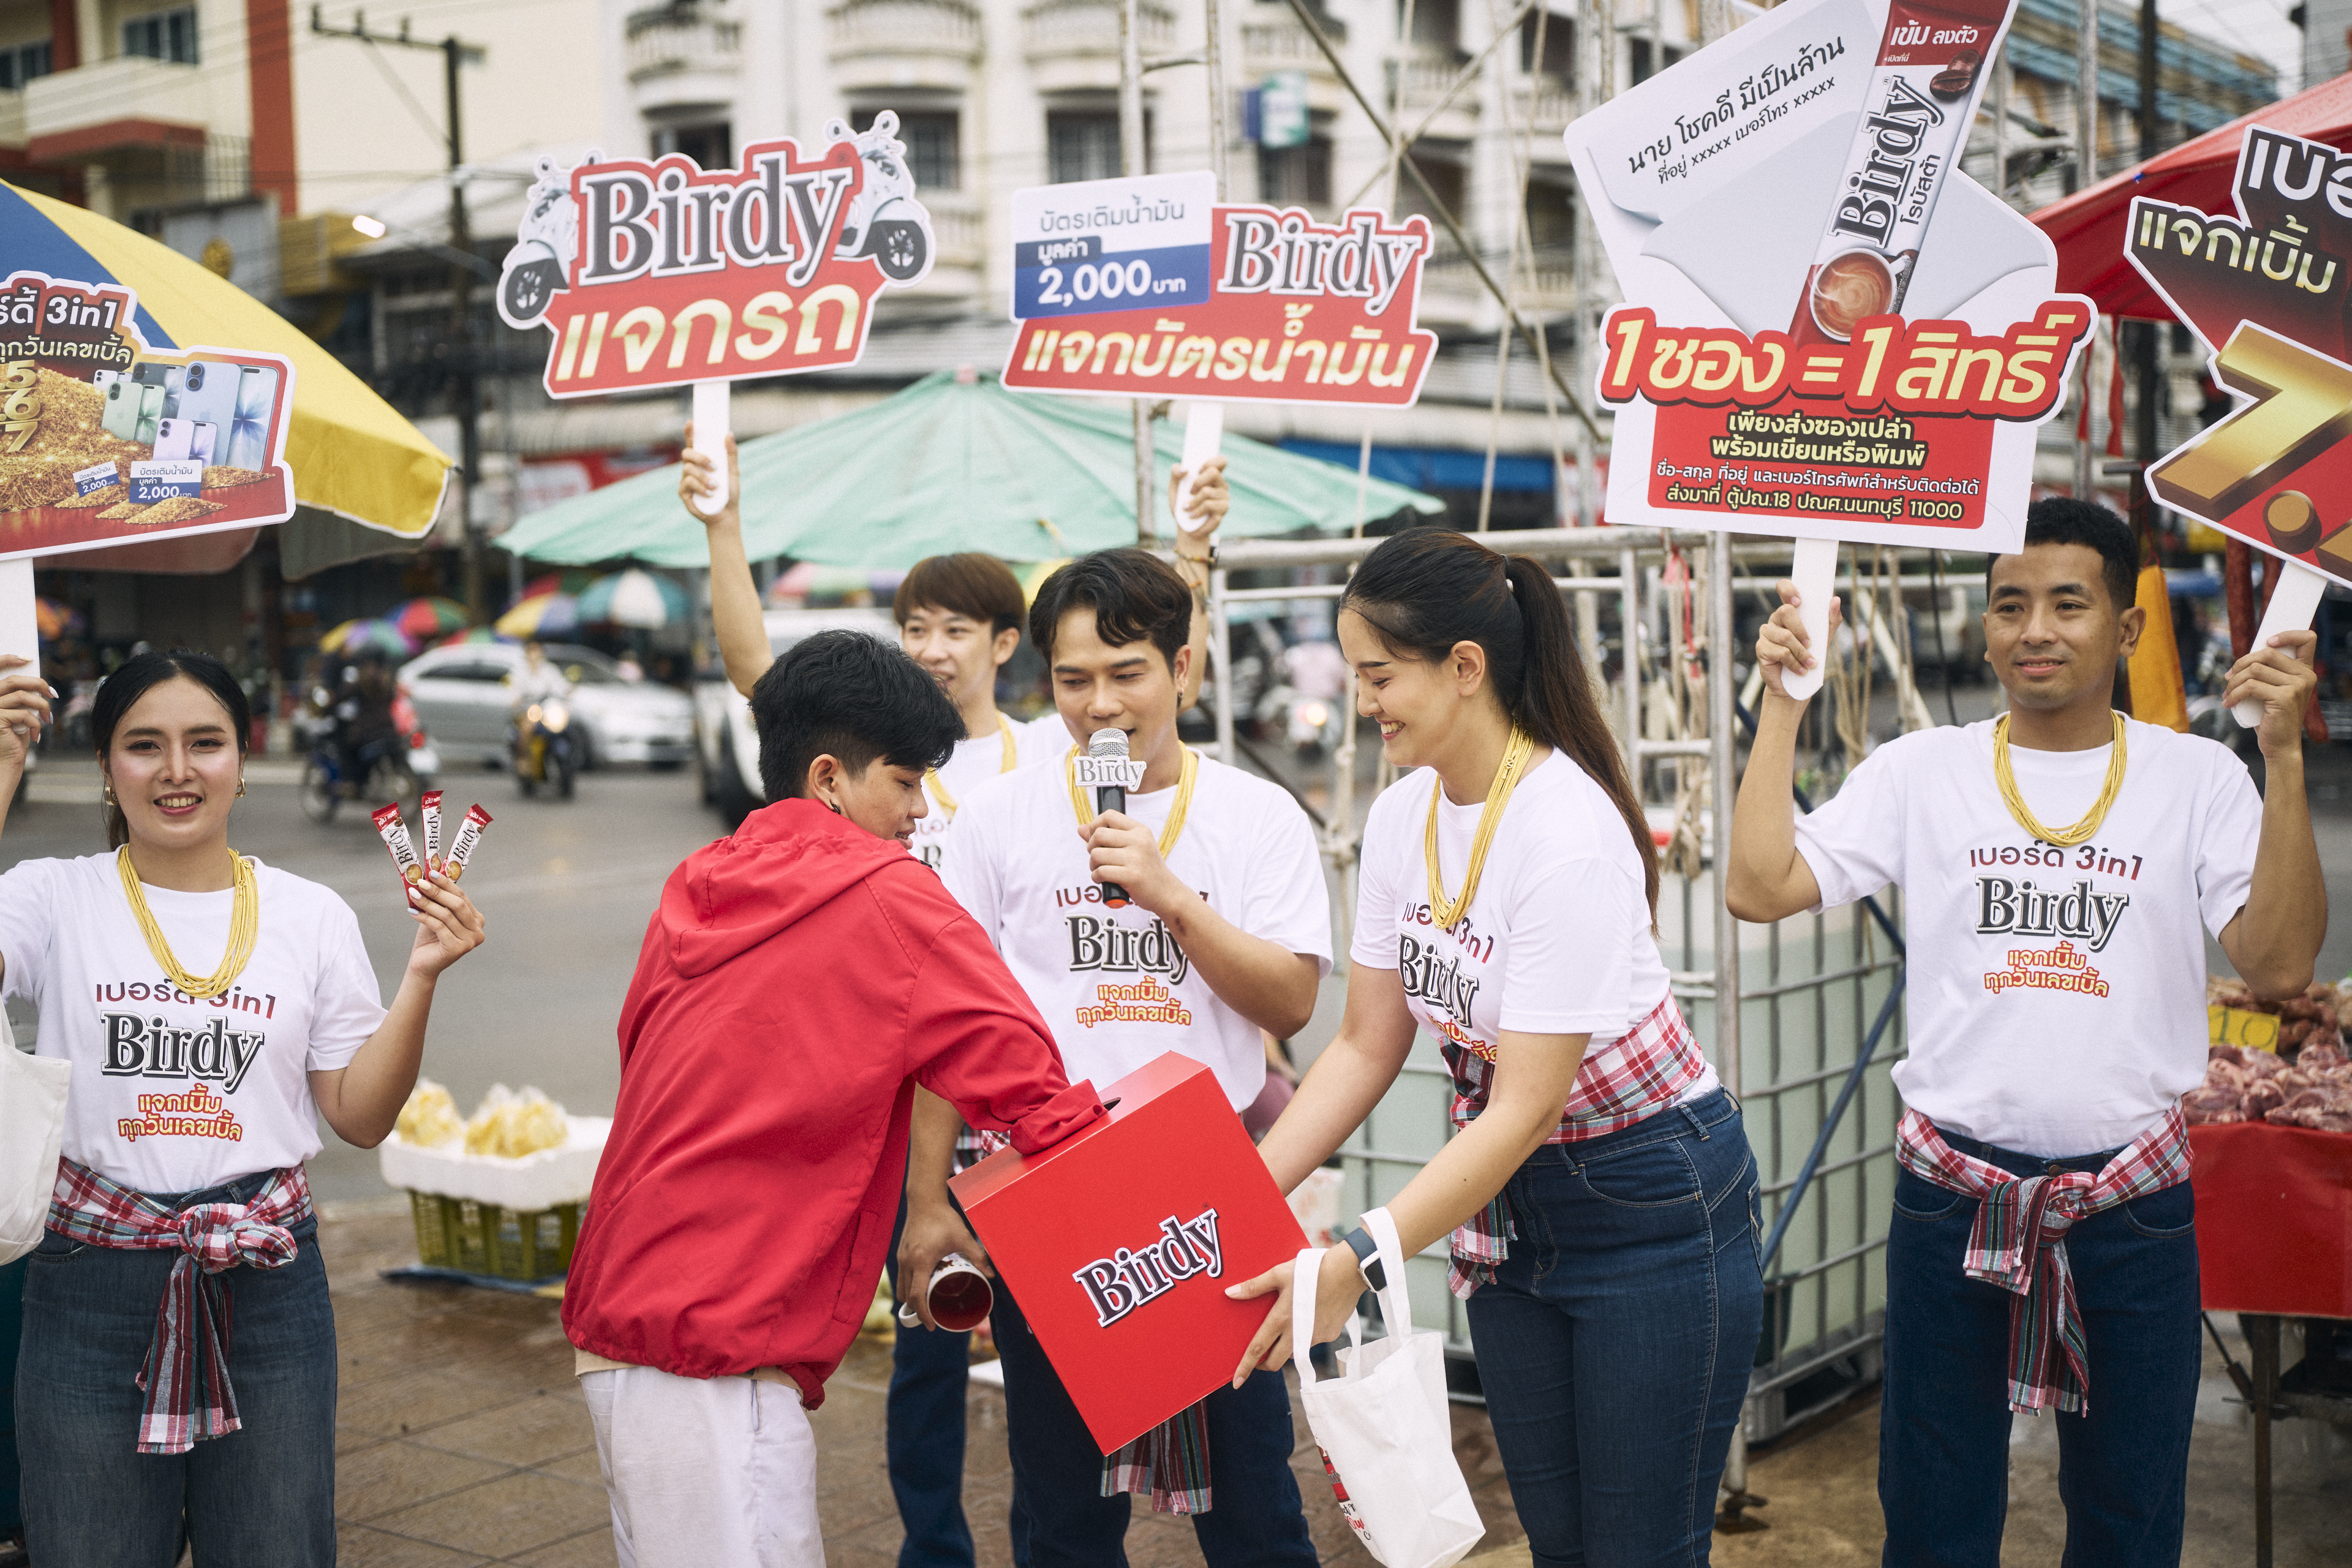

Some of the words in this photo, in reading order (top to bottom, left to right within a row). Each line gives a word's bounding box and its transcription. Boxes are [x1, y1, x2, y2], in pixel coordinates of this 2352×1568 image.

[1890, 20, 1931, 45] เข้ม
[1932, 26, 1978, 45] ลงตัว
[1629, 135, 1672, 173] นาย
[1675, 89, 1735, 144] โชคดี
[1739, 36, 1845, 110] มีเป็นล้าน
[1658, 160, 1687, 184] ที่อยู่
[1735, 101, 1788, 141] เบอร์โทร
[1827, 75, 1945, 249] Birdy
[1900, 154, 1940, 225] โรบัสต้า
[578, 151, 854, 288] Birdy
[1041, 195, 1185, 232] บัตรเติมน้ำมัน
[1038, 239, 1088, 266] มูลค่า
[1218, 212, 1422, 317] Birdy
[2139, 214, 2337, 294] แจกเบิ้ม
[1038, 259, 1152, 306] 2,000
[1153, 276, 1186, 294] บาท
[46, 296, 117, 329] 3in1
[555, 284, 861, 381] แจกรถ
[1022, 303, 1415, 387] แจกบัตรน้ำมัน
[1896, 314, 2077, 404] สิทธิ์
[1729, 410, 1912, 439] เพียงส่งซองเปล่า
[1712, 434, 1925, 466] พร้อมเขียนหรือพิมพ์
[83, 479, 107, 493] 2,000
[139, 477, 157, 487] มูลค่า
[140, 465, 193, 475] บัตรเติมน้ำมัน
[1657, 458, 1713, 483] ชื่อ-สกุล
[1718, 461, 1748, 485] ที่อยู่
[1754, 469, 1980, 495] และเบอร์โทรศัพท์สำหรับติดต่อได้
[138, 486, 179, 500] 2,000
[1667, 482, 1721, 503] ส่งมาที่
[1727, 488, 1790, 509] ตู้ปณ.18
[1797, 493, 1902, 519] ปณศ.นนทบุรี
[1910, 501, 1962, 519] 11000
[1074, 756, 1147, 792] Birdy
[387, 829, 414, 865] Birdy
[427, 810, 440, 850] Birdy
[453, 823, 479, 861] Birdy
[2076, 845, 2143, 881] 3in1
[1975, 873, 2130, 952] Birdy
[1065, 913, 1188, 985] Birdy
[2008, 941, 2086, 970] แจกเบิ้ม
[1098, 976, 1169, 1001] แจกเบิ้ม
[1398, 929, 1479, 1028] Birdy
[1985, 967, 2109, 998] ทุกวันเลขเบิ้ล
[1077, 998, 1191, 1028] ทุกวันเลขเบิ้ล
[101, 1009, 265, 1095] Birdy
[138, 1083, 222, 1114] แจกเบิ้ม
[118, 1110, 243, 1142] ทุกวันเลขเบิ้ล
[1072, 1207, 1219, 1329] Birdy
